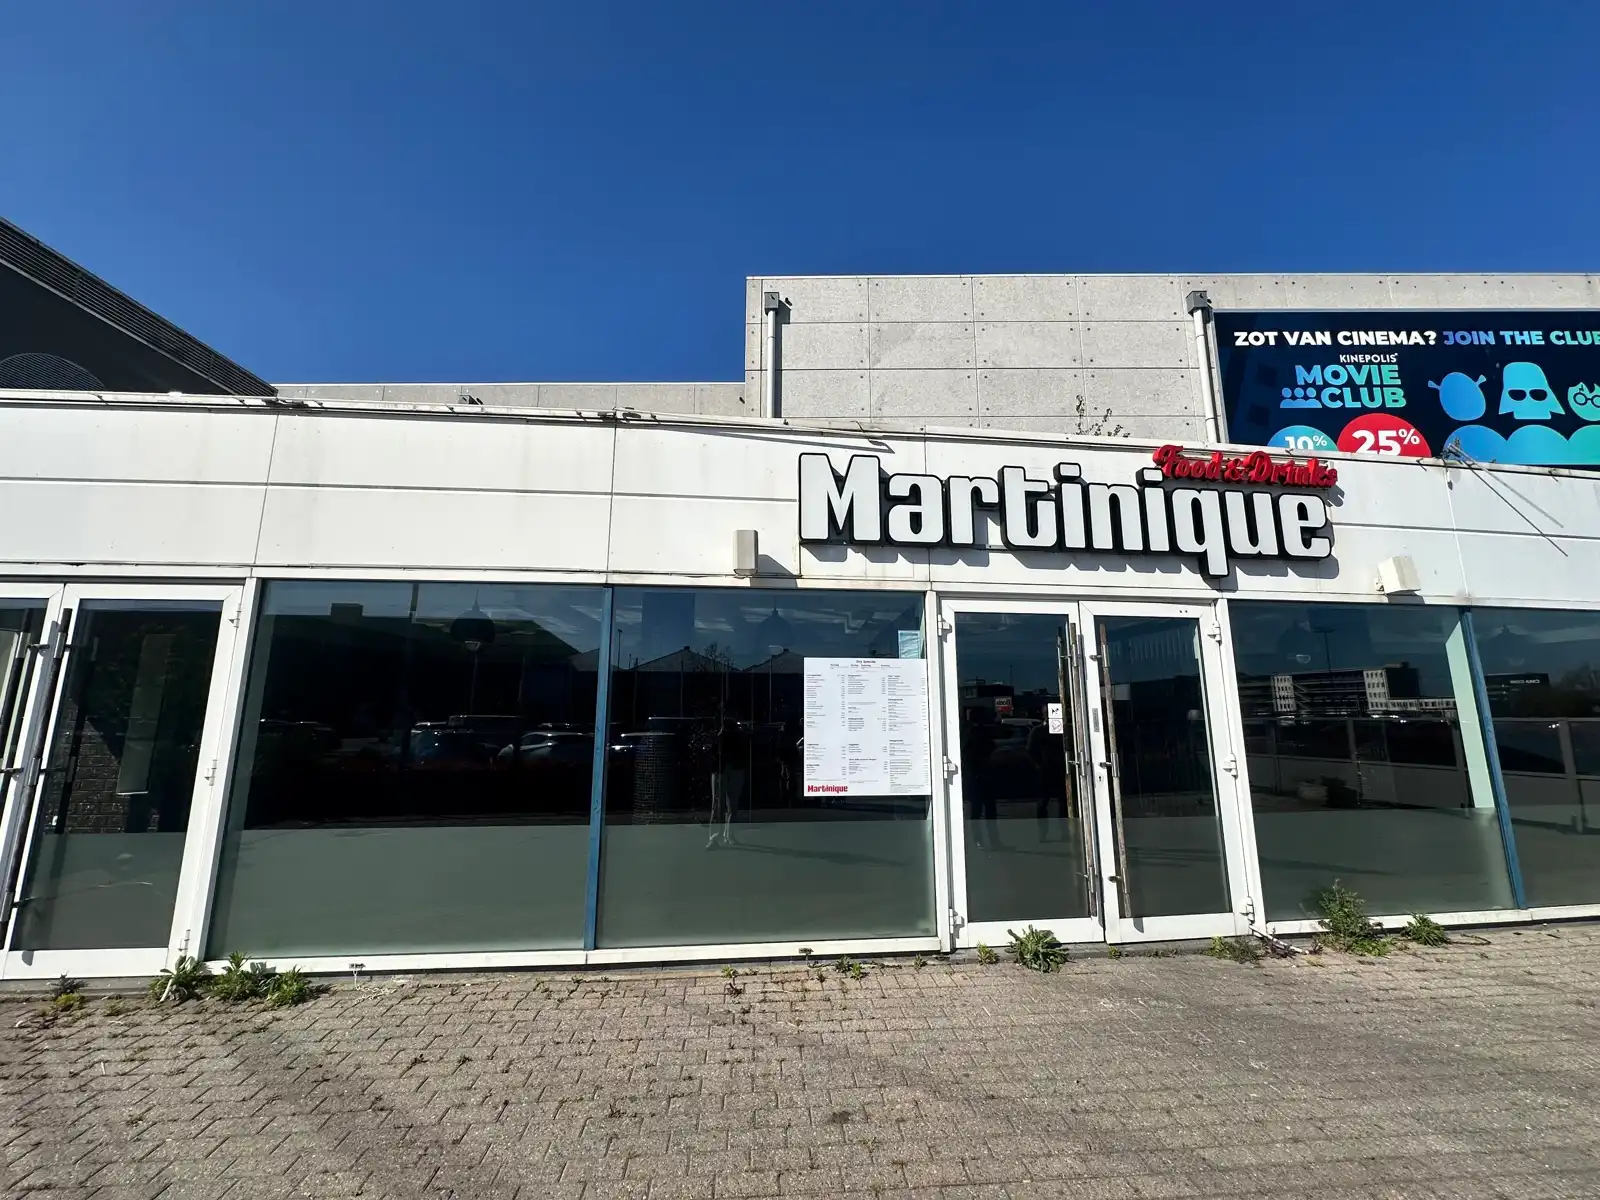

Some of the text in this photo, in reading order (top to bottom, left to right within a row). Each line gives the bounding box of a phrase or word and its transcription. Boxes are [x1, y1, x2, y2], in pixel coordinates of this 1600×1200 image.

[1234, 331, 1278, 347] ZOT
[1283, 331, 1334, 346] VAN
[1336, 330, 1436, 346] CINEMA?
[1442, 330, 1495, 346] JOIN
[1500, 330, 1545, 346] THE
[1339, 352, 1398, 363] KINEPOLIS
[1295, 364, 1402, 386] MOVIE
[1320, 387, 1407, 409] CLUB
[1284, 435, 1328, 451] 10%
[1352, 428, 1421, 456] 25%
[1152, 444, 1224, 480] Food
[1242, 450, 1339, 488] Drinks
[798, 451, 1334, 579] Martinique
[807, 784, 848, 794] Martinique
